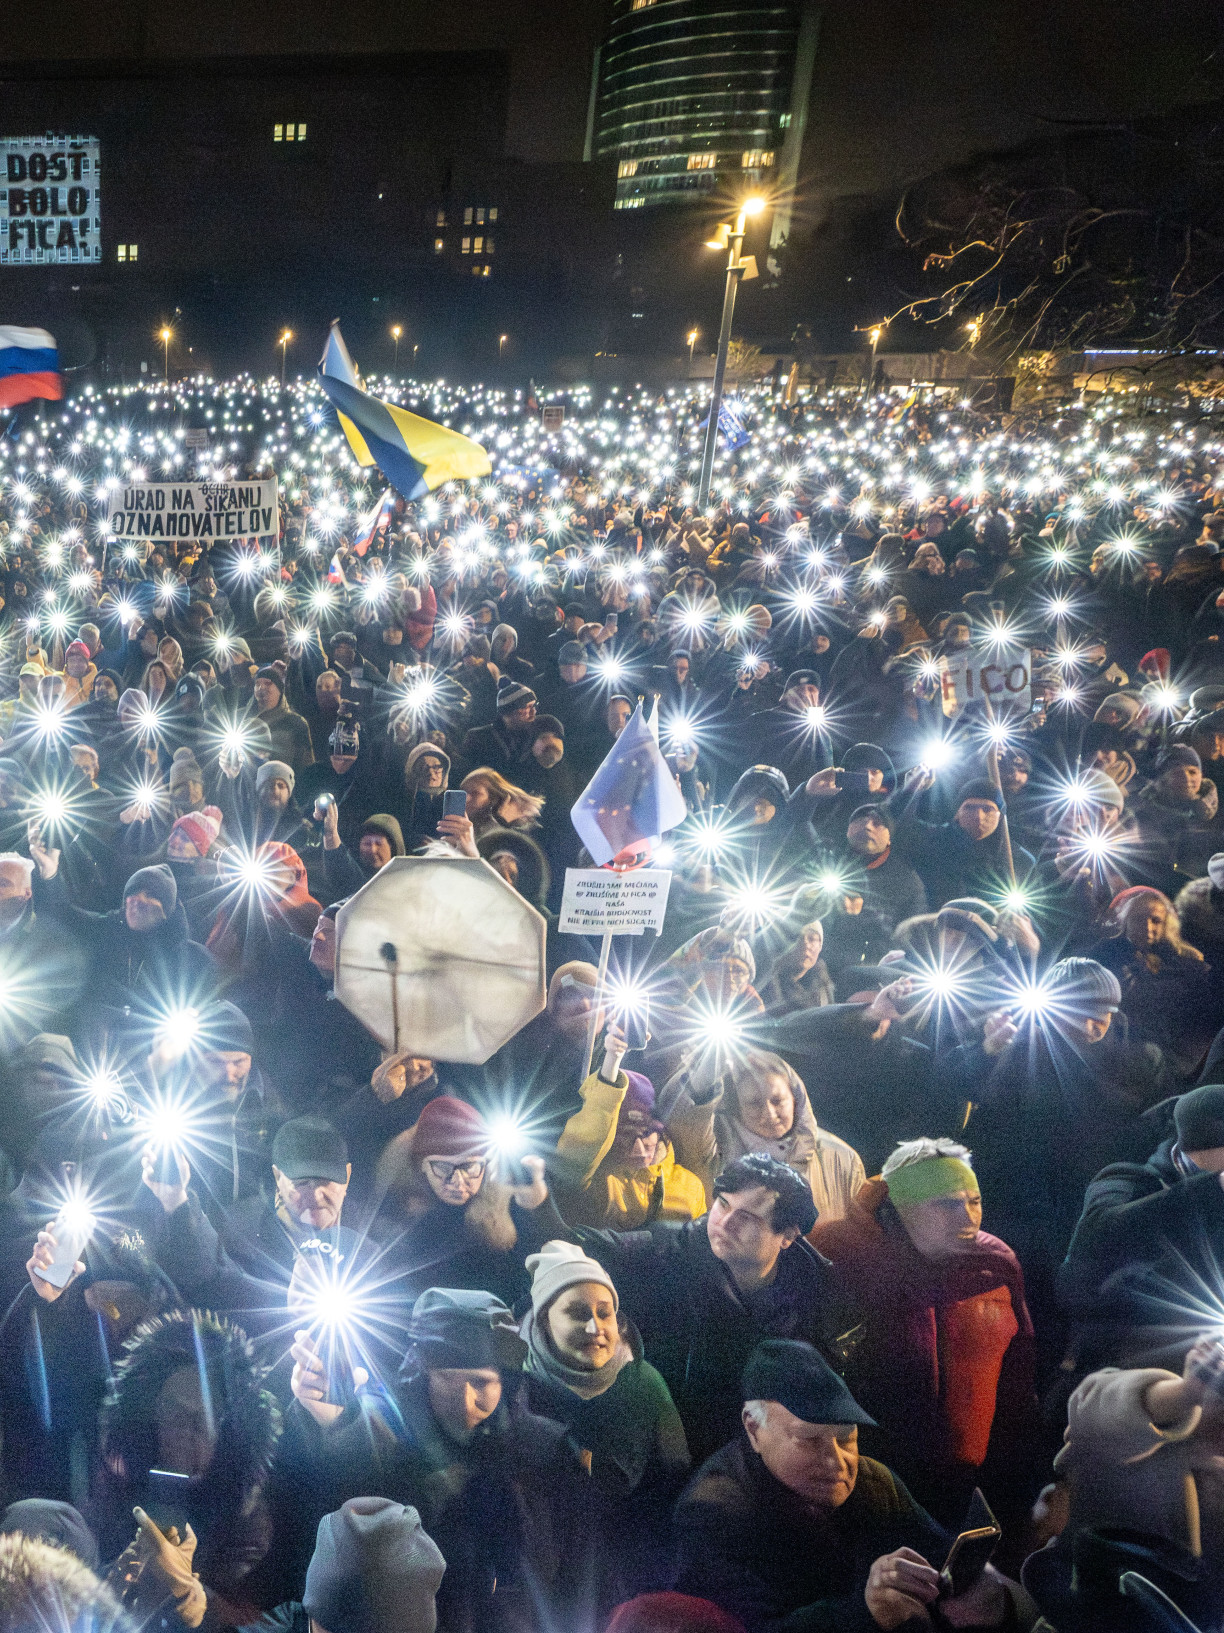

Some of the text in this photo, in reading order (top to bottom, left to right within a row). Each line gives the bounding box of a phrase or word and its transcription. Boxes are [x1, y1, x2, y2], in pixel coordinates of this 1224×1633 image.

[8, 186, 87, 217] BOLO
[9, 217, 88, 250] FICA!
[123, 486, 166, 512] ÚRAD
[171, 488, 195, 511] NA
[112, 507, 273, 537] OZNAMOVATEĽOV
[942, 664, 1028, 700] FICO
